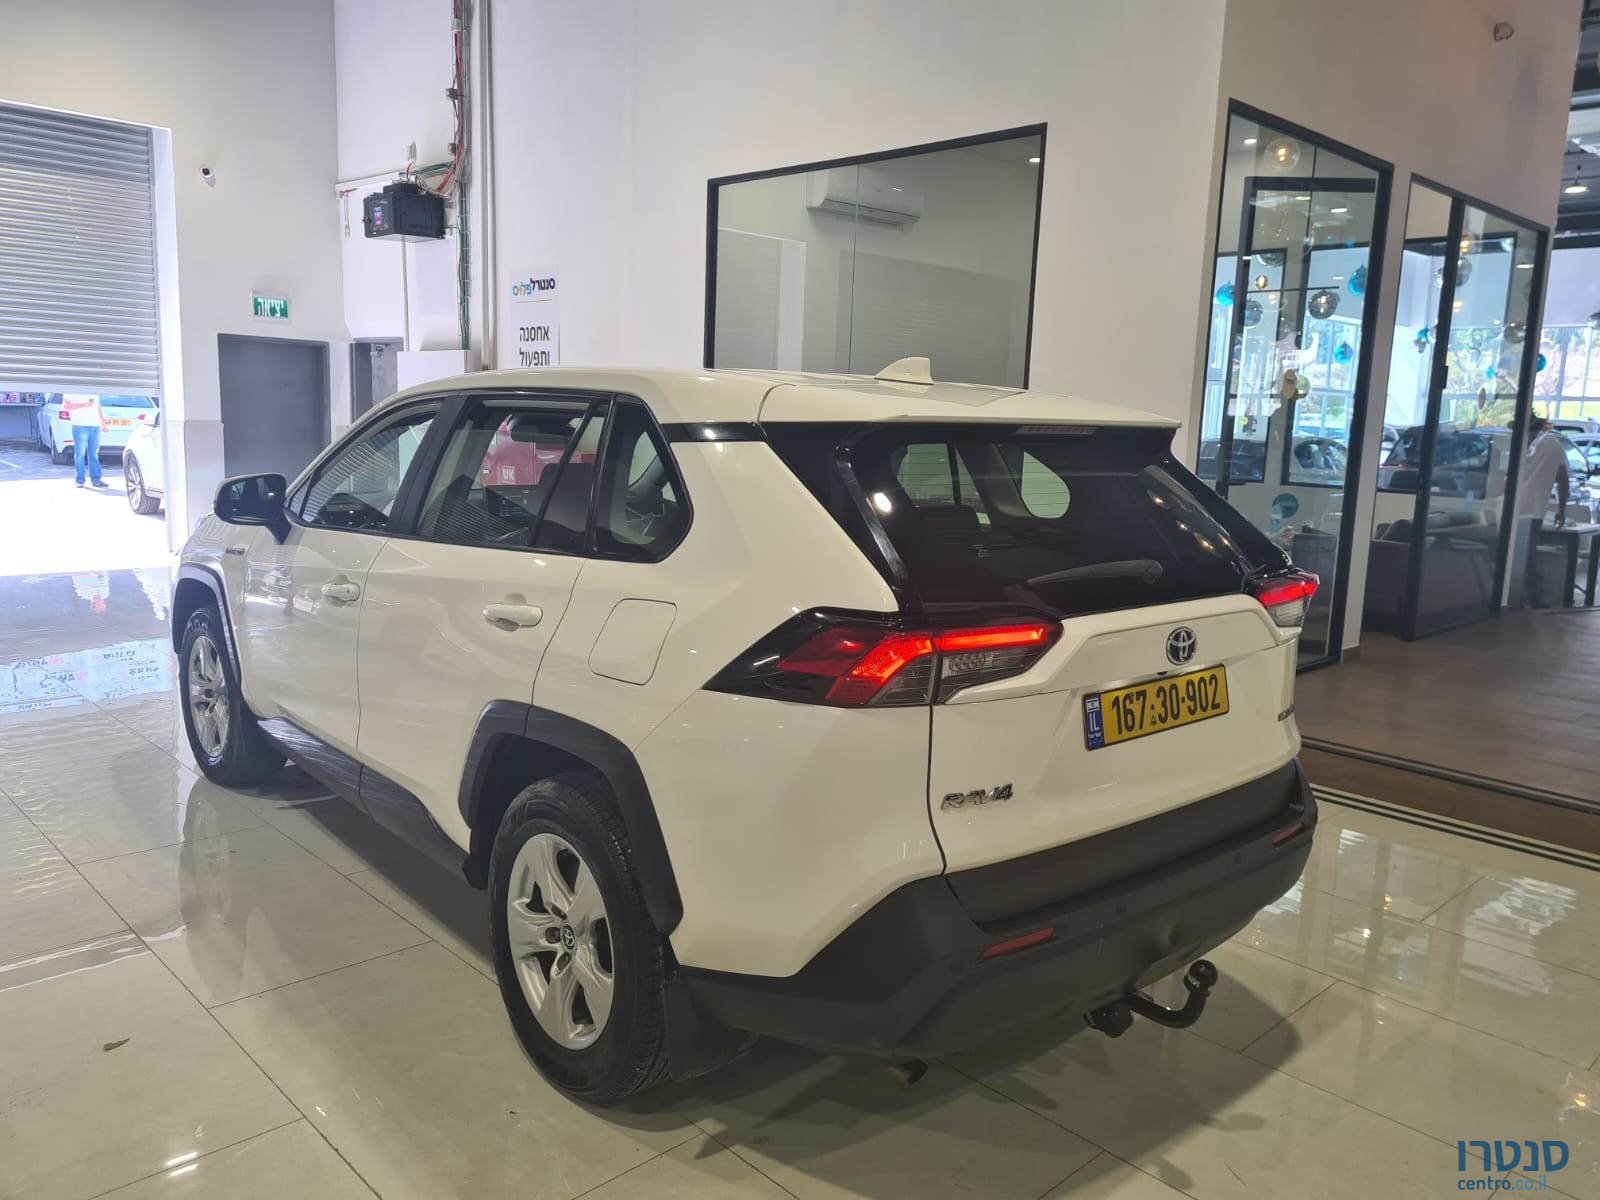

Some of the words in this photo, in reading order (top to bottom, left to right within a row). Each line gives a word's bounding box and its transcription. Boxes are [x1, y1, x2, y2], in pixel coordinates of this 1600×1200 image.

[257, 298, 284, 317] יציאה
[519, 326, 550, 341] אחסנה
[519, 347, 550, 367] ותפעול
[1089, 712, 1100, 732] IL
[941, 783, 1013, 810] RAV4
